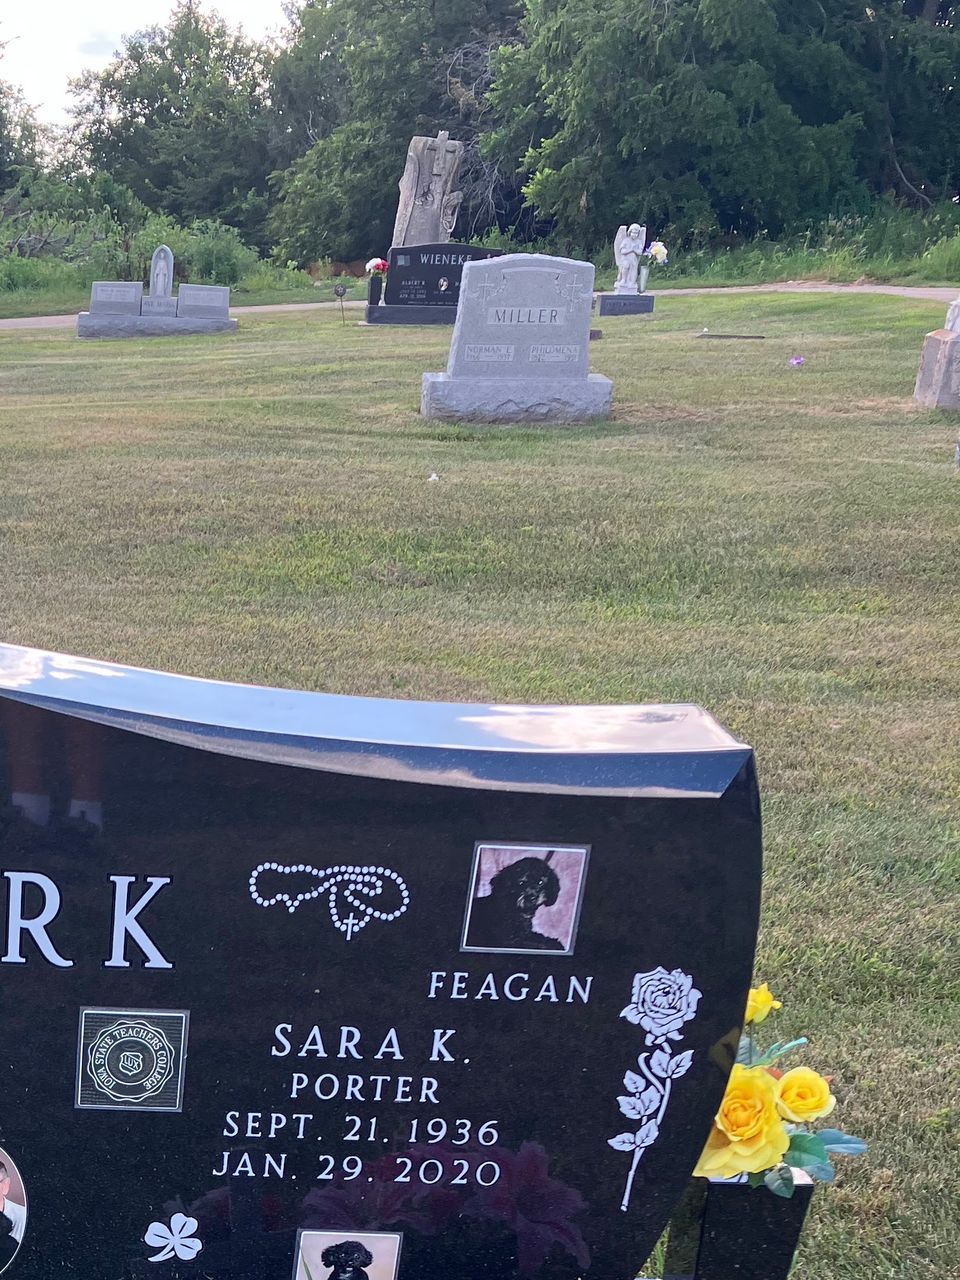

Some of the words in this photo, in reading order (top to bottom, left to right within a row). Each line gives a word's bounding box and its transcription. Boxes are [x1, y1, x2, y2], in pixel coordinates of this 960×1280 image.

[420, 253, 472, 265] WIENEKE
[495, 309, 558, 324] MILLER
[467, 345, 502, 354] NORMAN
[427, 971, 594, 1004] FEAGAN
[95, 1036, 114, 1064] STATE
[113, 1027, 163, 1050] TEACHERS
[271, 1023, 405, 1060] SARA
[429, 1029, 471, 1064] K.
[124, 1055, 139, 1070] LUX
[143, 1050, 167, 1090] COLLEGE
[96, 1066, 117, 1089] IOWA
[290, 1072, 440, 1104] PORTER
[223, 1110, 322, 1141] SEPT.
[343, 1115, 389, 1143] 21.
[408, 1117, 499, 1146] 1936
[212, 1151, 297, 1180] JAN.
[316, 1154, 373, 1182] 29.
[393, 1157, 500, 1186] 2020
